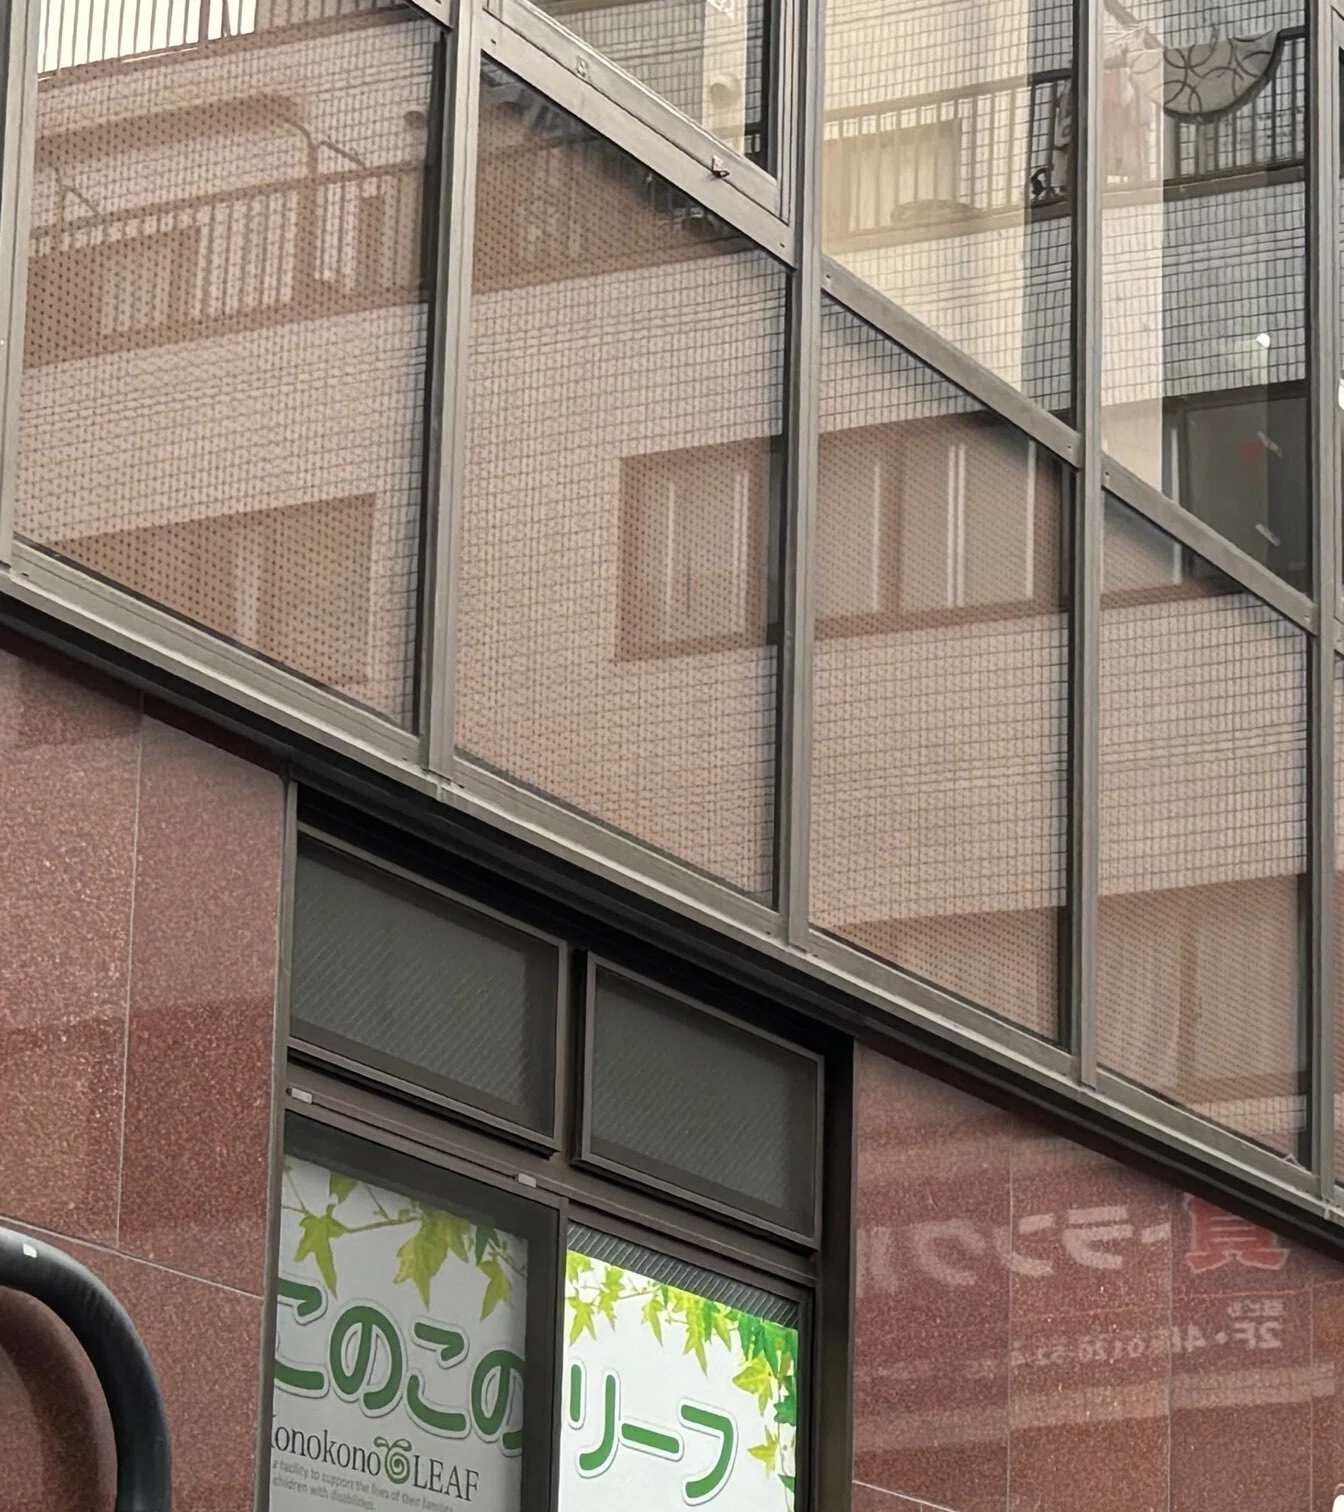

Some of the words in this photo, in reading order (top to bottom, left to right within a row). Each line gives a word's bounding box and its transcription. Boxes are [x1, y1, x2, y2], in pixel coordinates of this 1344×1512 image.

[271, 1426, 381, 1476] onokono
[412, 1454, 480, 1501] LEAF
[568, 1362, 737, 1501] リーフ
